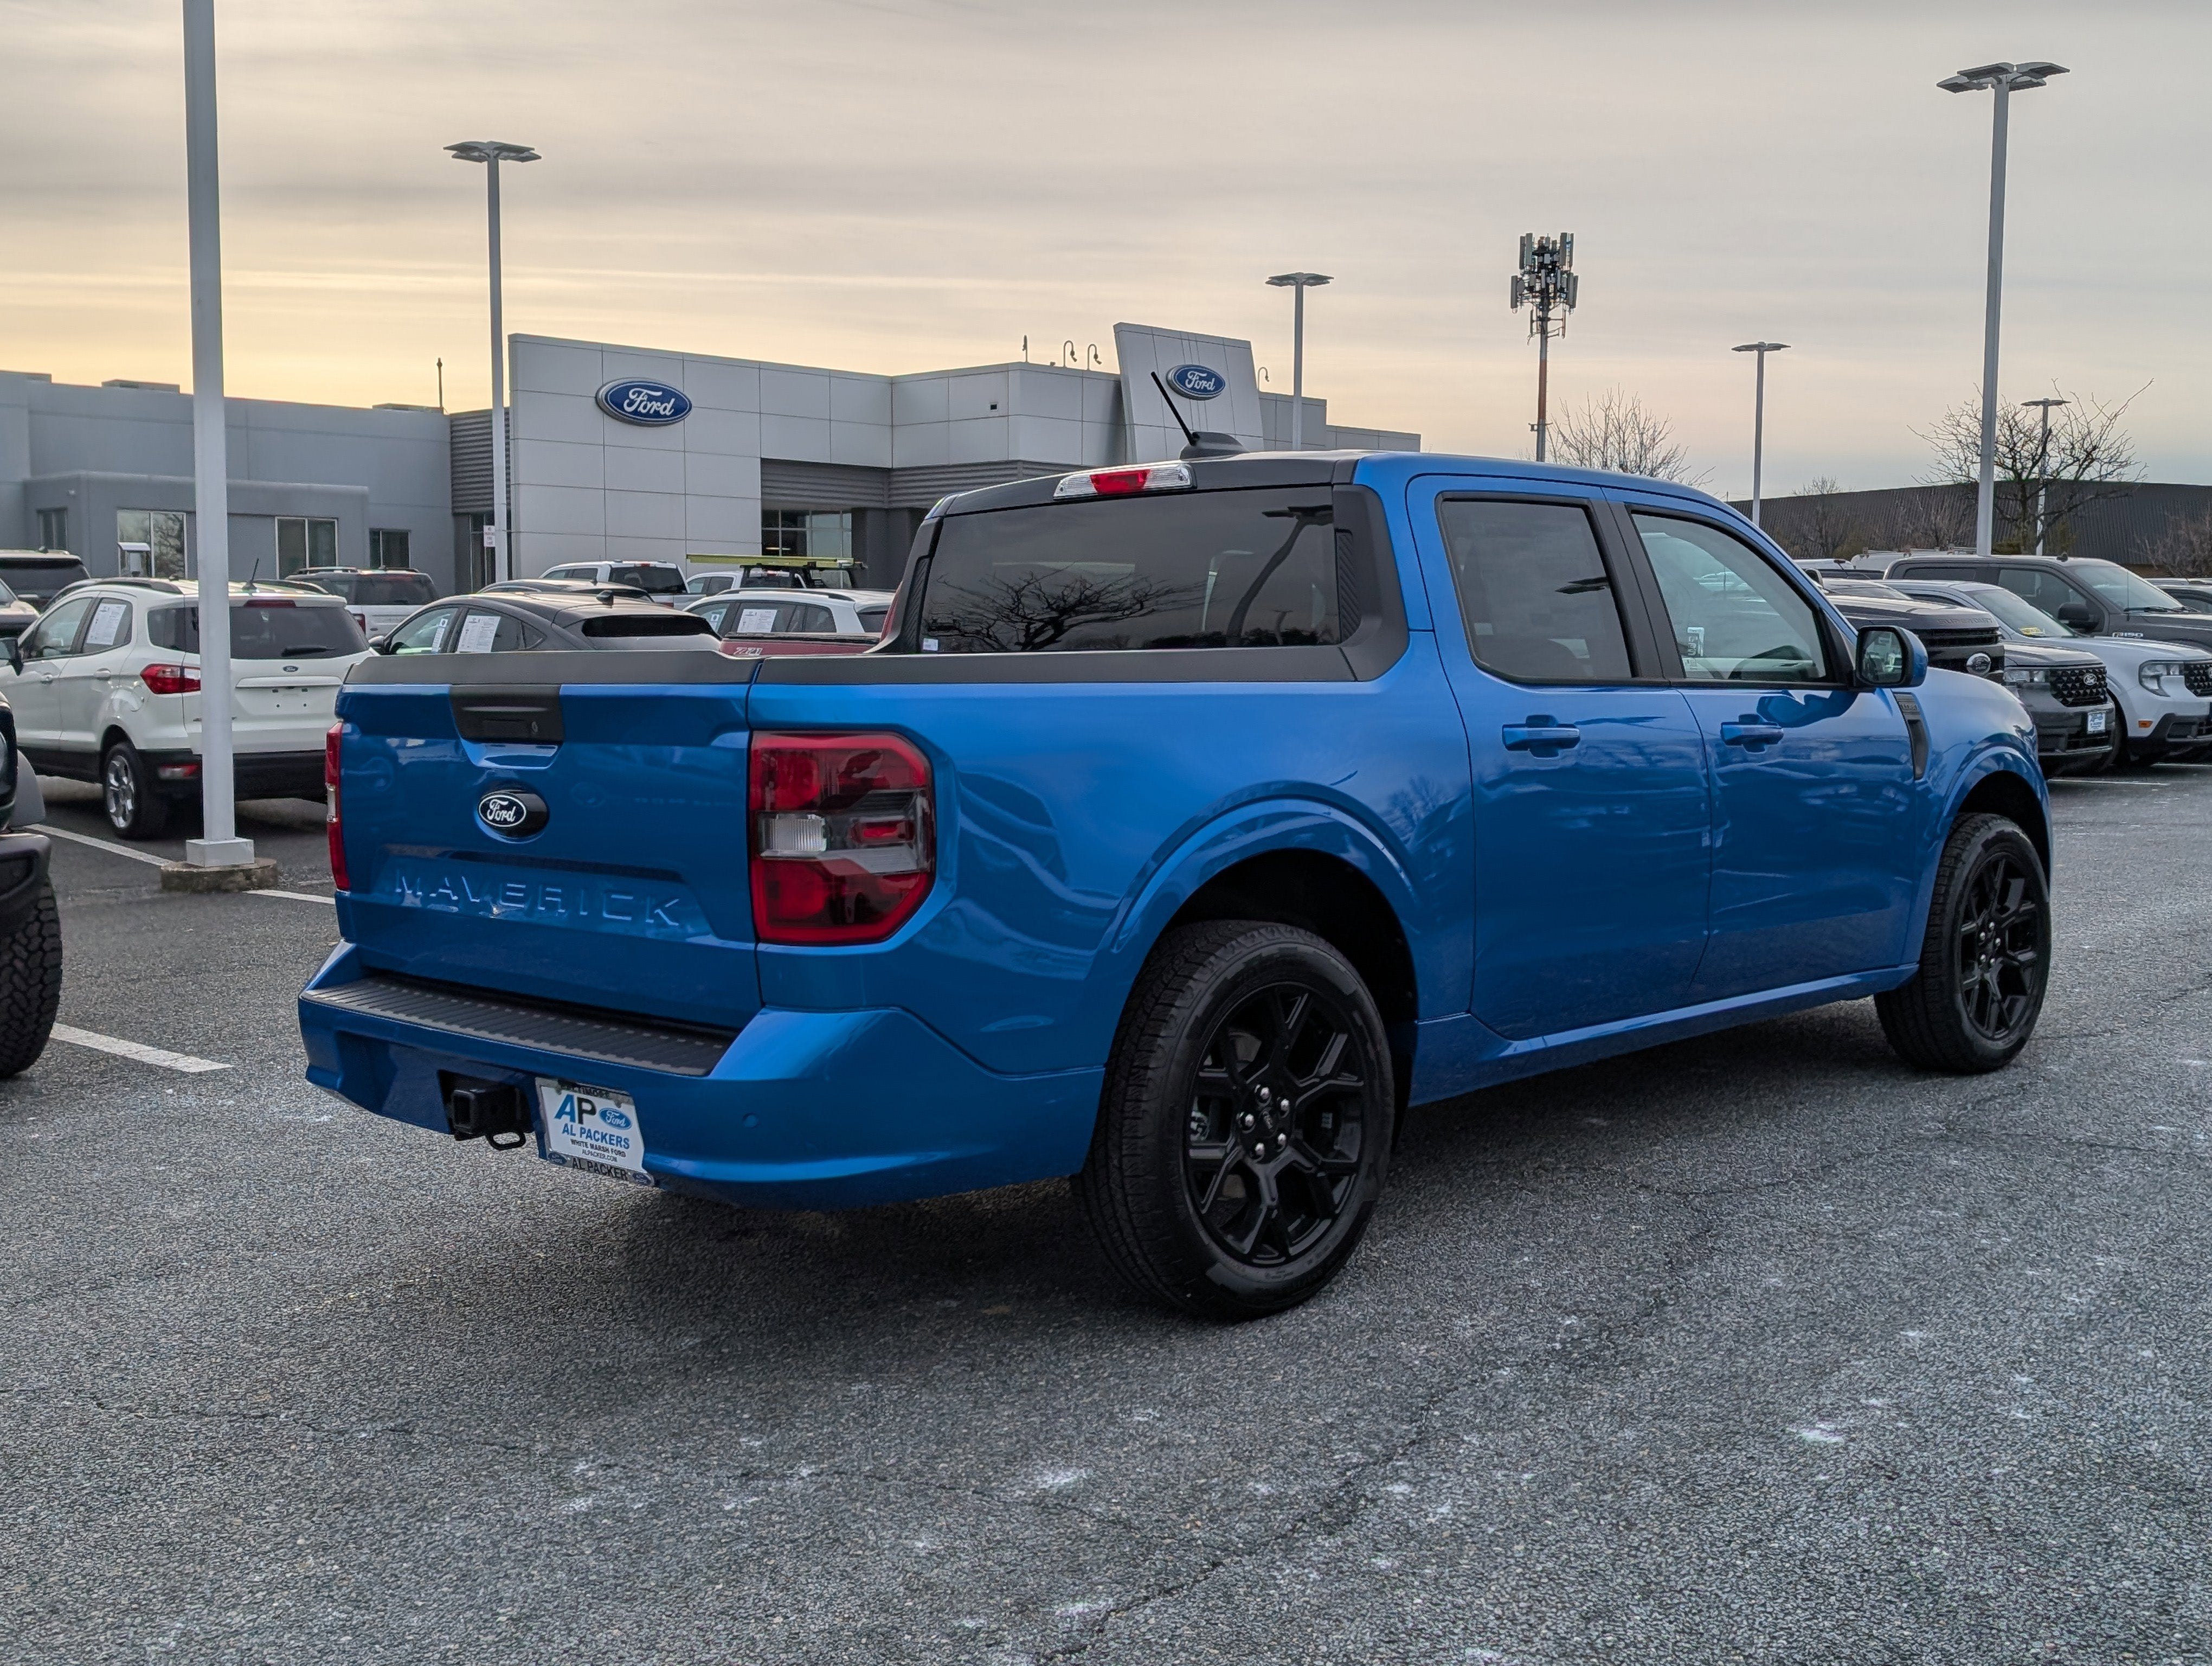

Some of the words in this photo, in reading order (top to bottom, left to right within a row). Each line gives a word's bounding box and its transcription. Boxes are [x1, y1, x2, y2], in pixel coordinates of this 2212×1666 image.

[1185, 371, 1216, 390] Ford
[623, 388, 676, 416] Ford
[487, 799, 517, 823] Ford
[395, 869, 680, 926] MAVERICK
[554, 1094, 596, 1125] AP
[606, 1110, 627, 1127] Ford
[562, 1123, 576, 1136] AL
[580, 1126, 629, 1149] PACKERS
[570, 1138, 589, 1149] WHITE
[589, 1143, 610, 1154] MARSH
[611, 1148, 626, 1158] FORD
[573, 1157, 586, 1170] AL
[587, 1161, 628, 1181] PACKER
